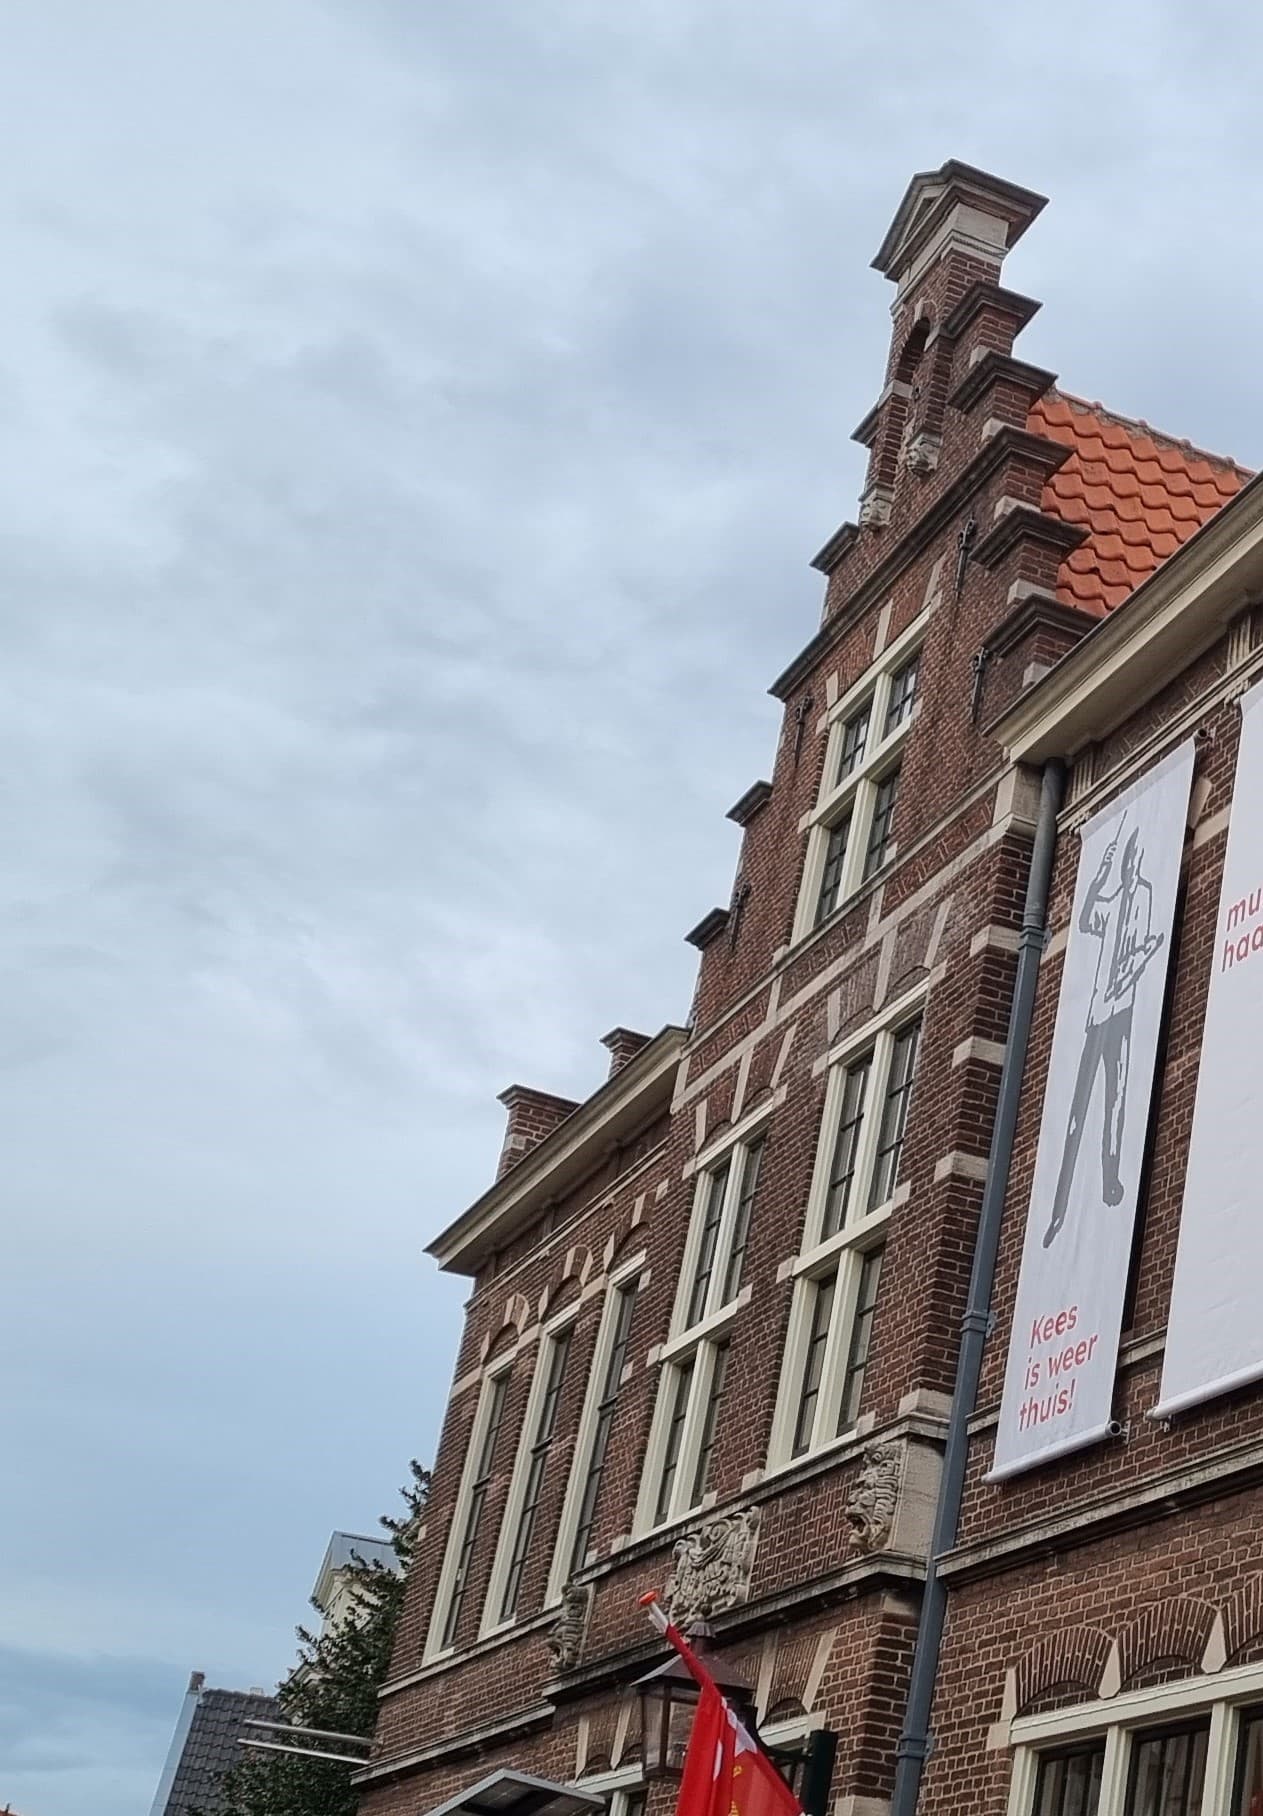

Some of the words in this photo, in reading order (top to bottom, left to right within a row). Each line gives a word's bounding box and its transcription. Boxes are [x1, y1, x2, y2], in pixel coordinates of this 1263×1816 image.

[1030, 1305, 1078, 1349] Kees
[1025, 1356, 1040, 1391] is
[1048, 1334, 1098, 1378] weer
[1020, 1378, 1076, 1432] thuis!
